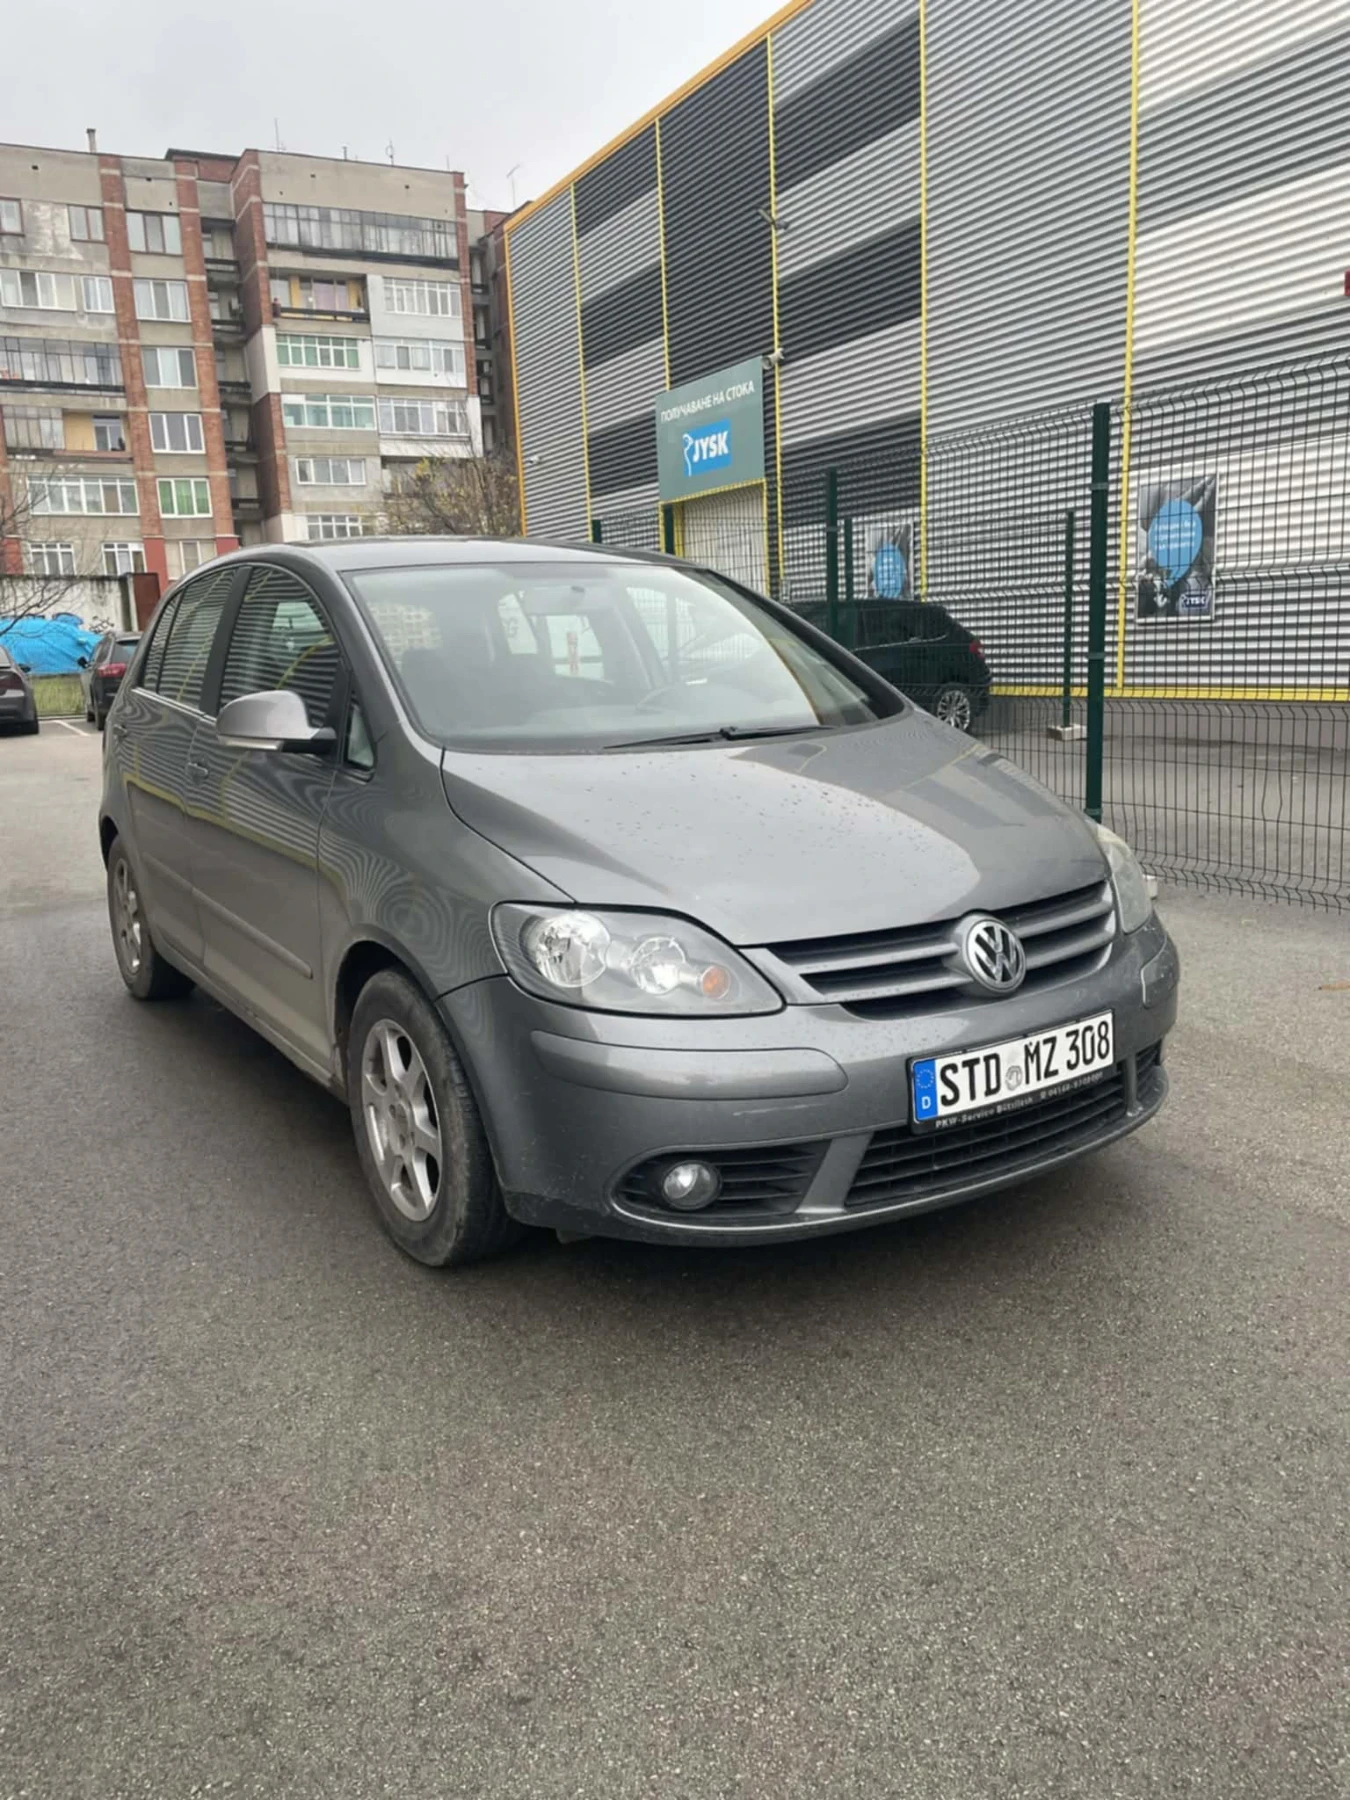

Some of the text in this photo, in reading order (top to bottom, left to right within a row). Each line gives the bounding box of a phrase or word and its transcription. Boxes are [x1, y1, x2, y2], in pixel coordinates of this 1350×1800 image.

[660, 380, 755, 422] ПОЛУЧАВАНЕ НА СТОКА
[692, 430, 729, 463] JYSK
[939, 1052, 1000, 1107] STD
[1024, 1036, 1059, 1085] MZ
[1065, 1020, 1110, 1071] 308
[921, 1096, 931, 1110] D
